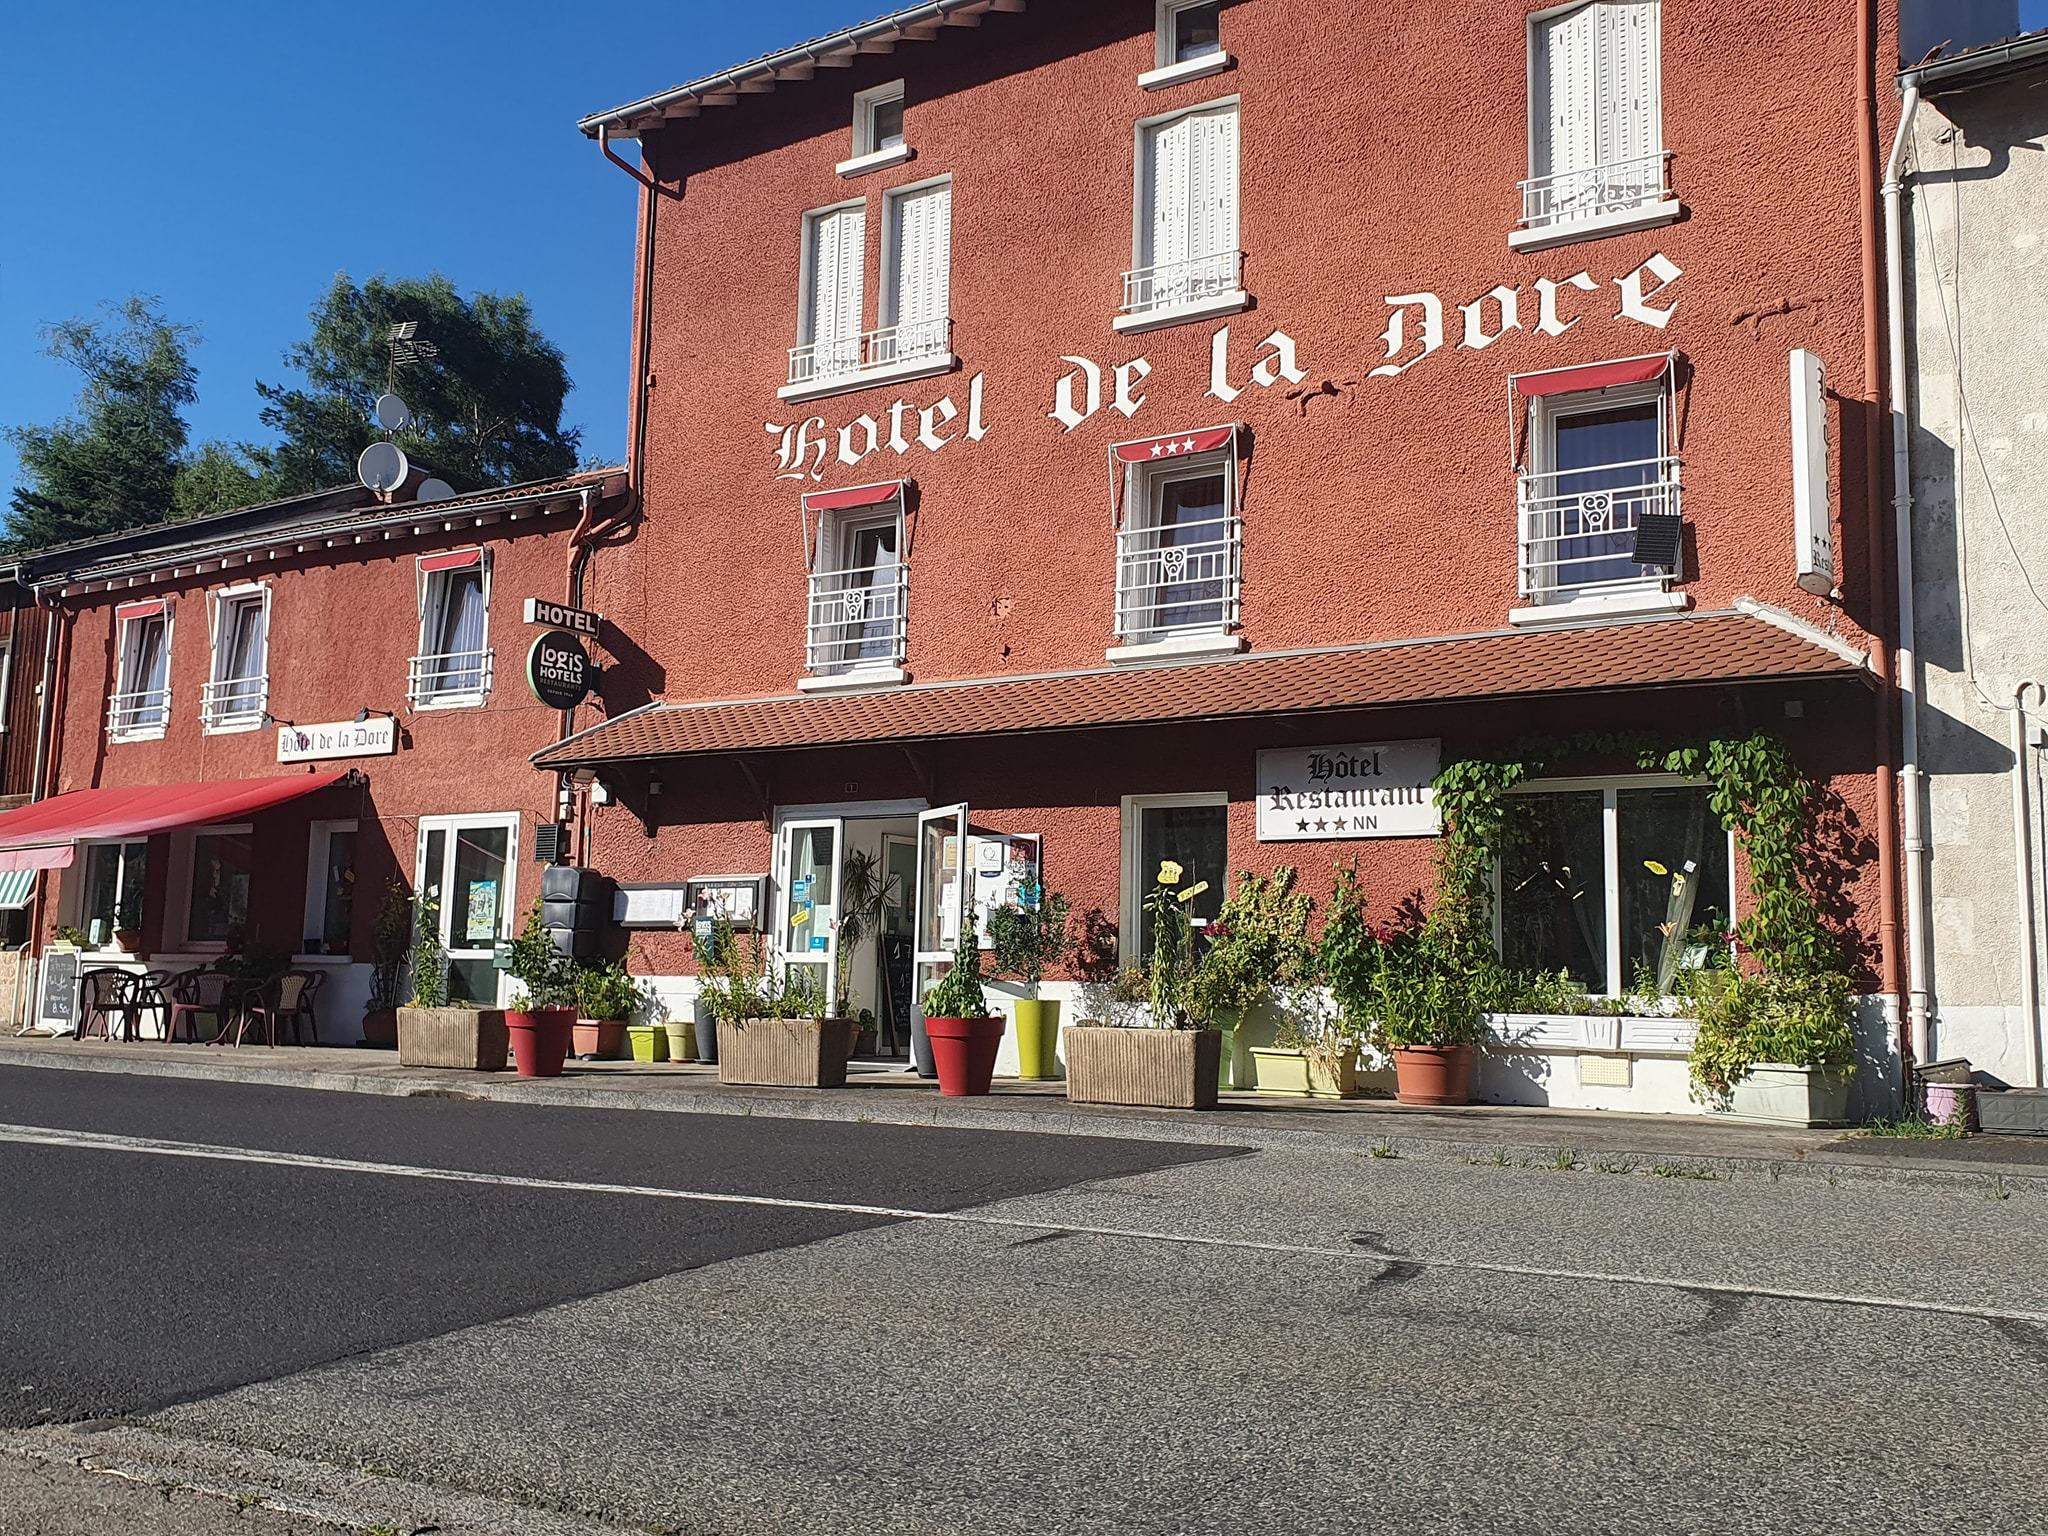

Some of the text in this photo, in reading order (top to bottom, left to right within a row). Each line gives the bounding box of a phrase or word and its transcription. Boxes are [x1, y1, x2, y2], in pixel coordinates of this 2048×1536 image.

[765, 252, 1684, 482] Hotel de la Dore
[536, 603, 596, 633] HOTEL
[540, 666, 582, 684] HOTELS
[319, 733, 333, 749] de
[338, 730, 349, 748] la
[354, 728, 389, 748] Dore
[1307, 751, 1383, 784] Hôtel
[1270, 782, 1425, 811] Restaurant
[1353, 815, 1378, 831] NN
